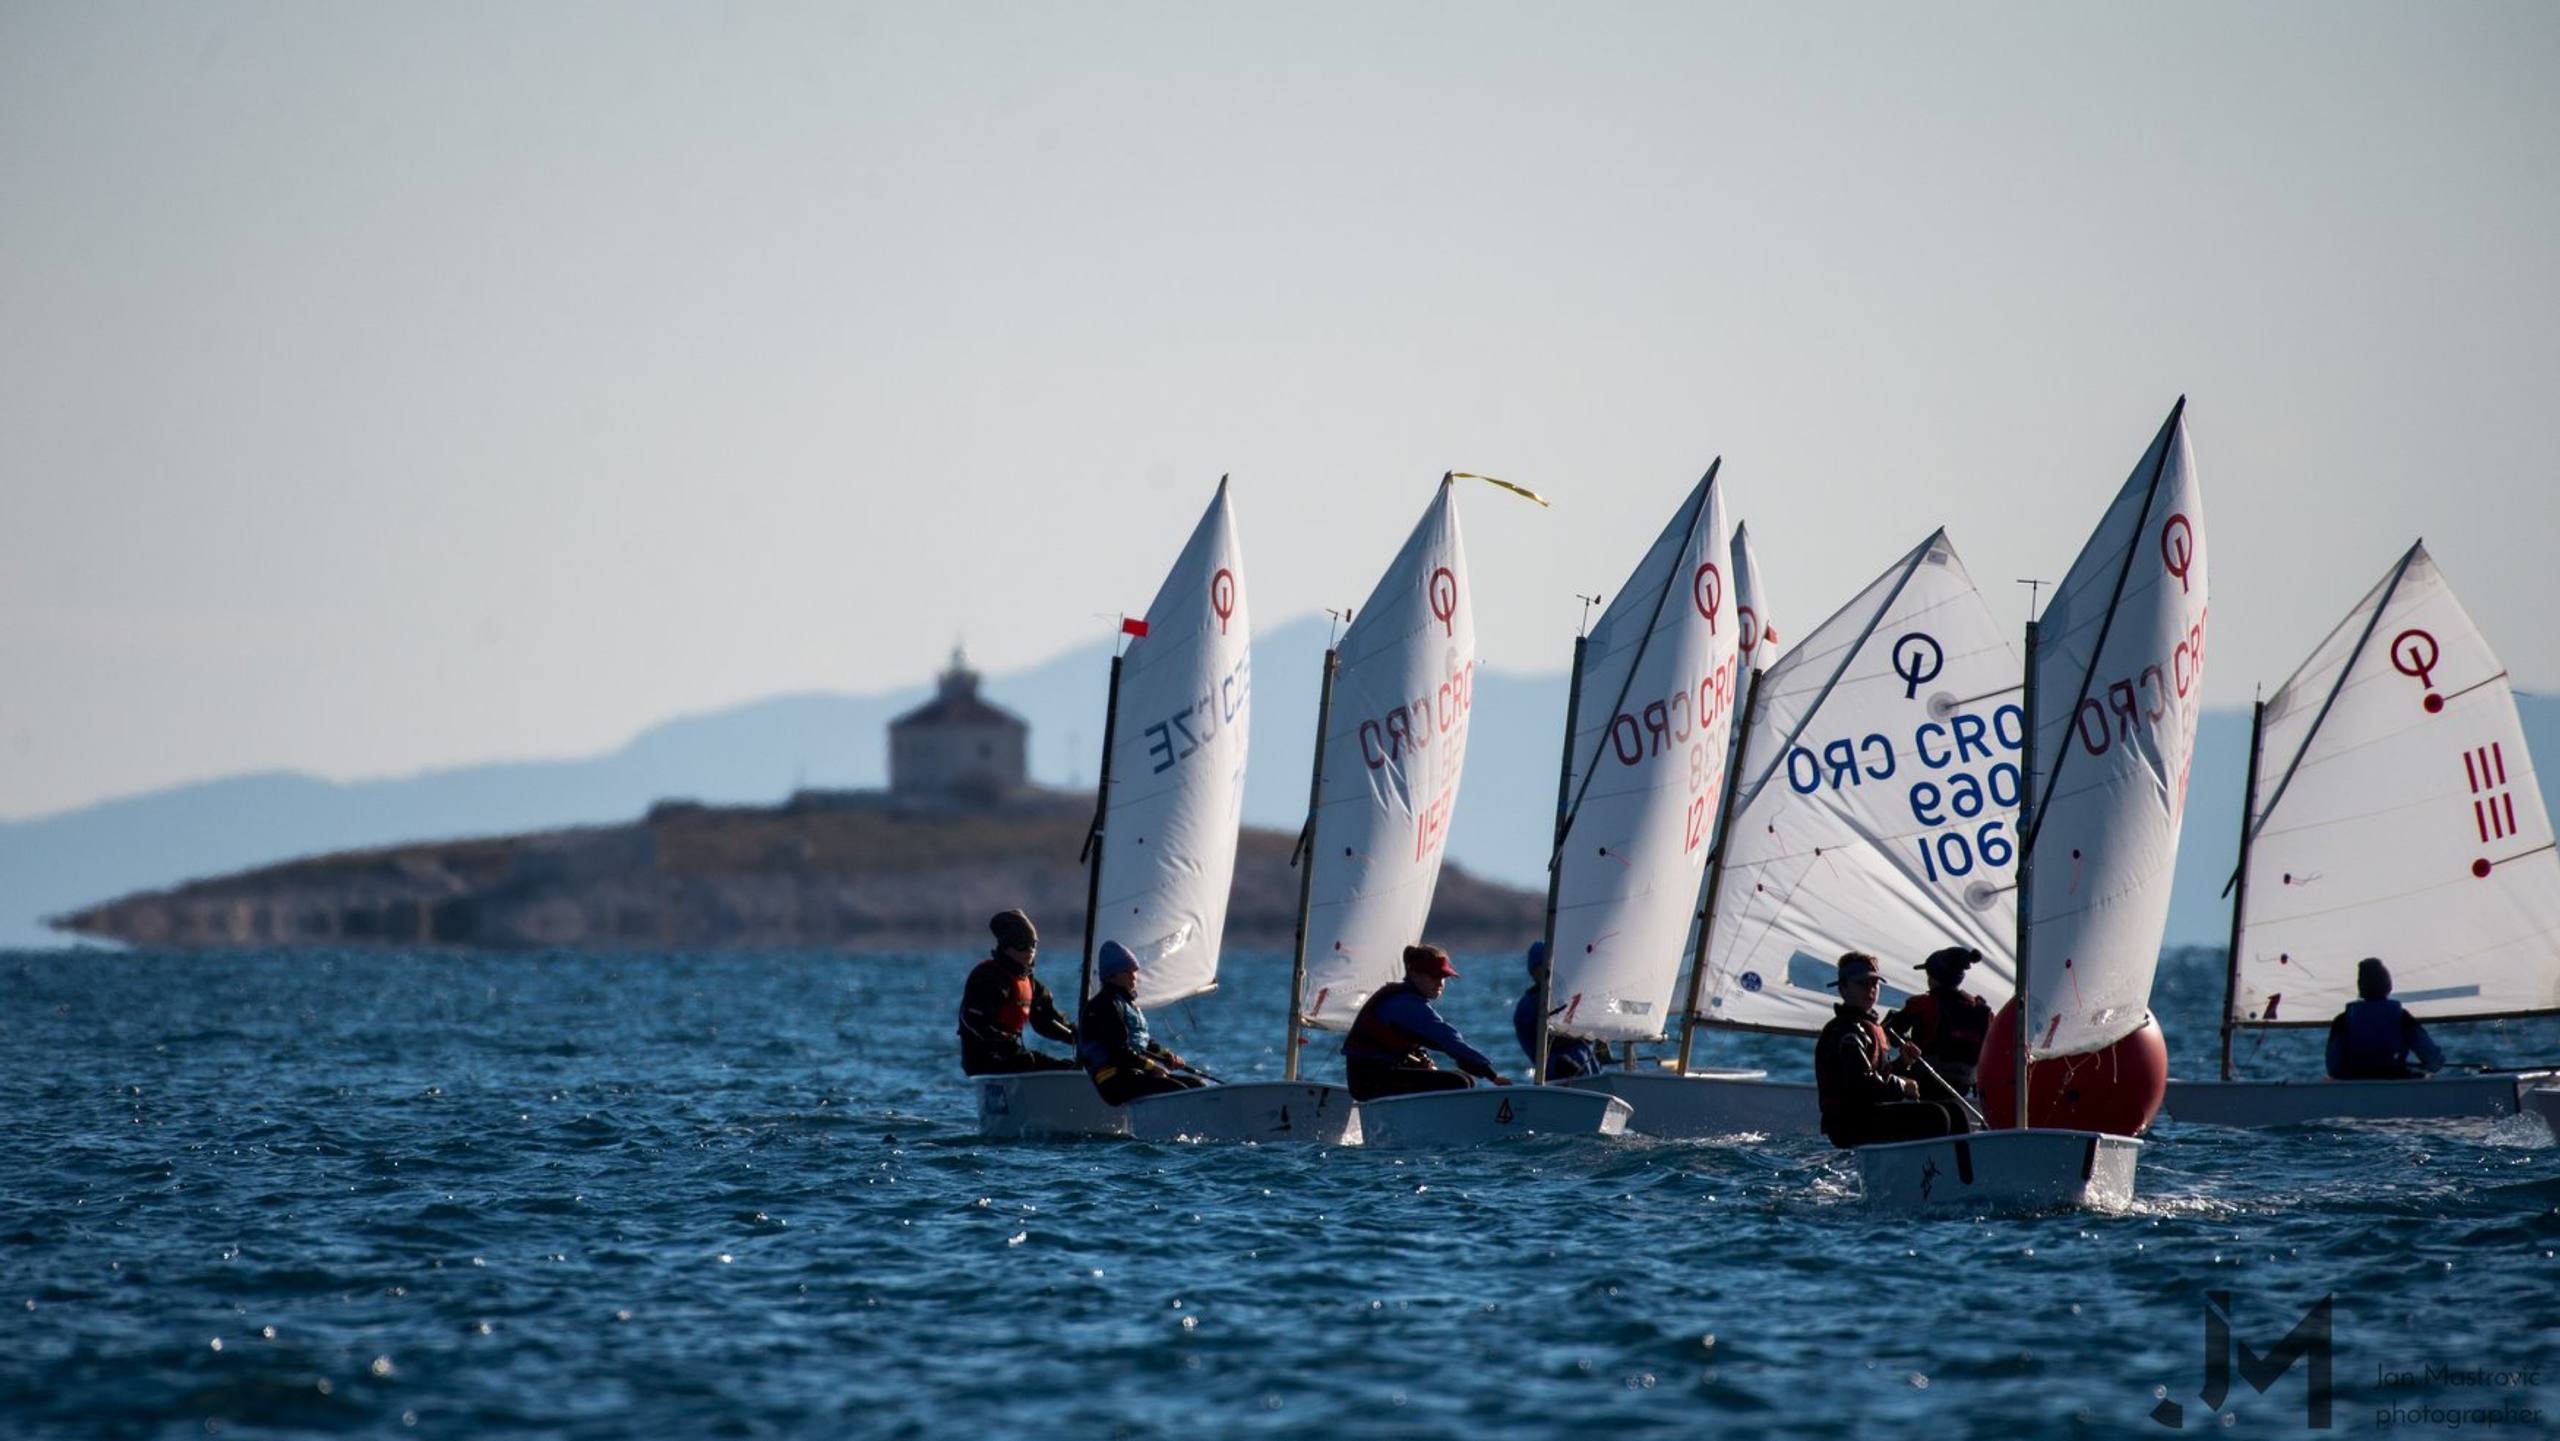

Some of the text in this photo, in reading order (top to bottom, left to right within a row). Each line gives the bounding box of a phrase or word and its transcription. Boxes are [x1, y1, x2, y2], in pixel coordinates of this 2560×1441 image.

[1699, 654, 1736, 729] CRO
[1915, 704, 2024, 770] CRO
[1917, 821, 2014, 882] 106
